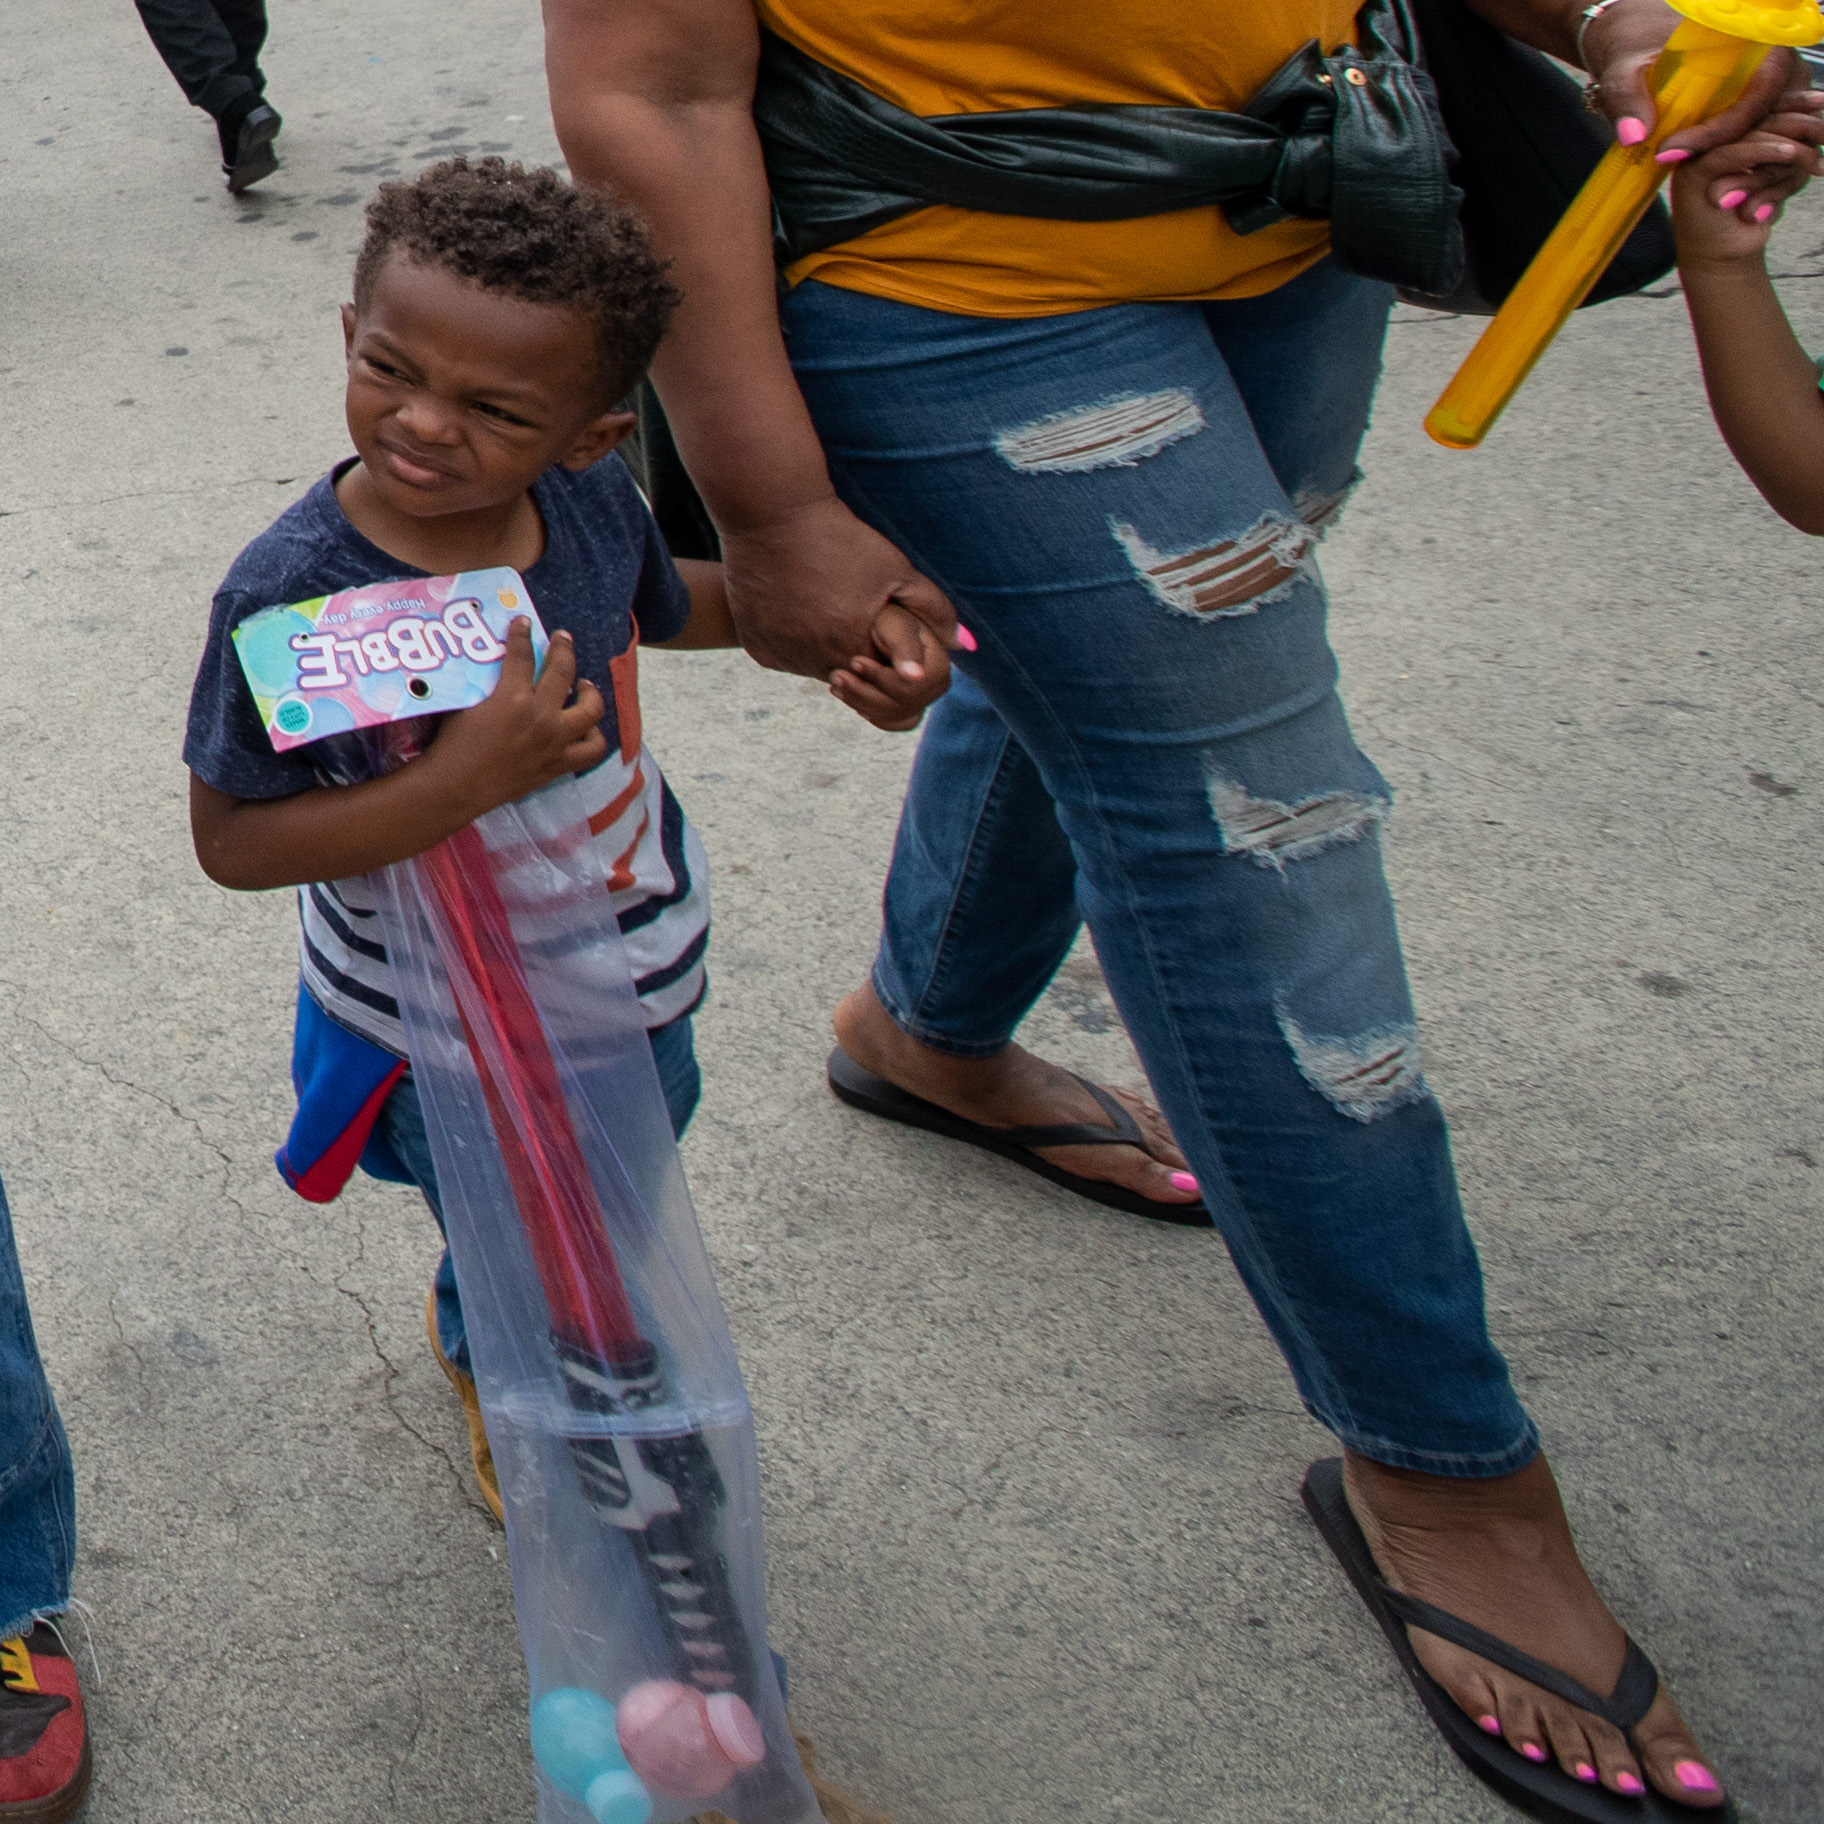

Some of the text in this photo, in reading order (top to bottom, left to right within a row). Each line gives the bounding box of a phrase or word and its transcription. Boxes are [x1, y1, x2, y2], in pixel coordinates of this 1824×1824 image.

[324, 598, 427, 626] Happy every day
[291, 599, 507, 689] BUBBLE
